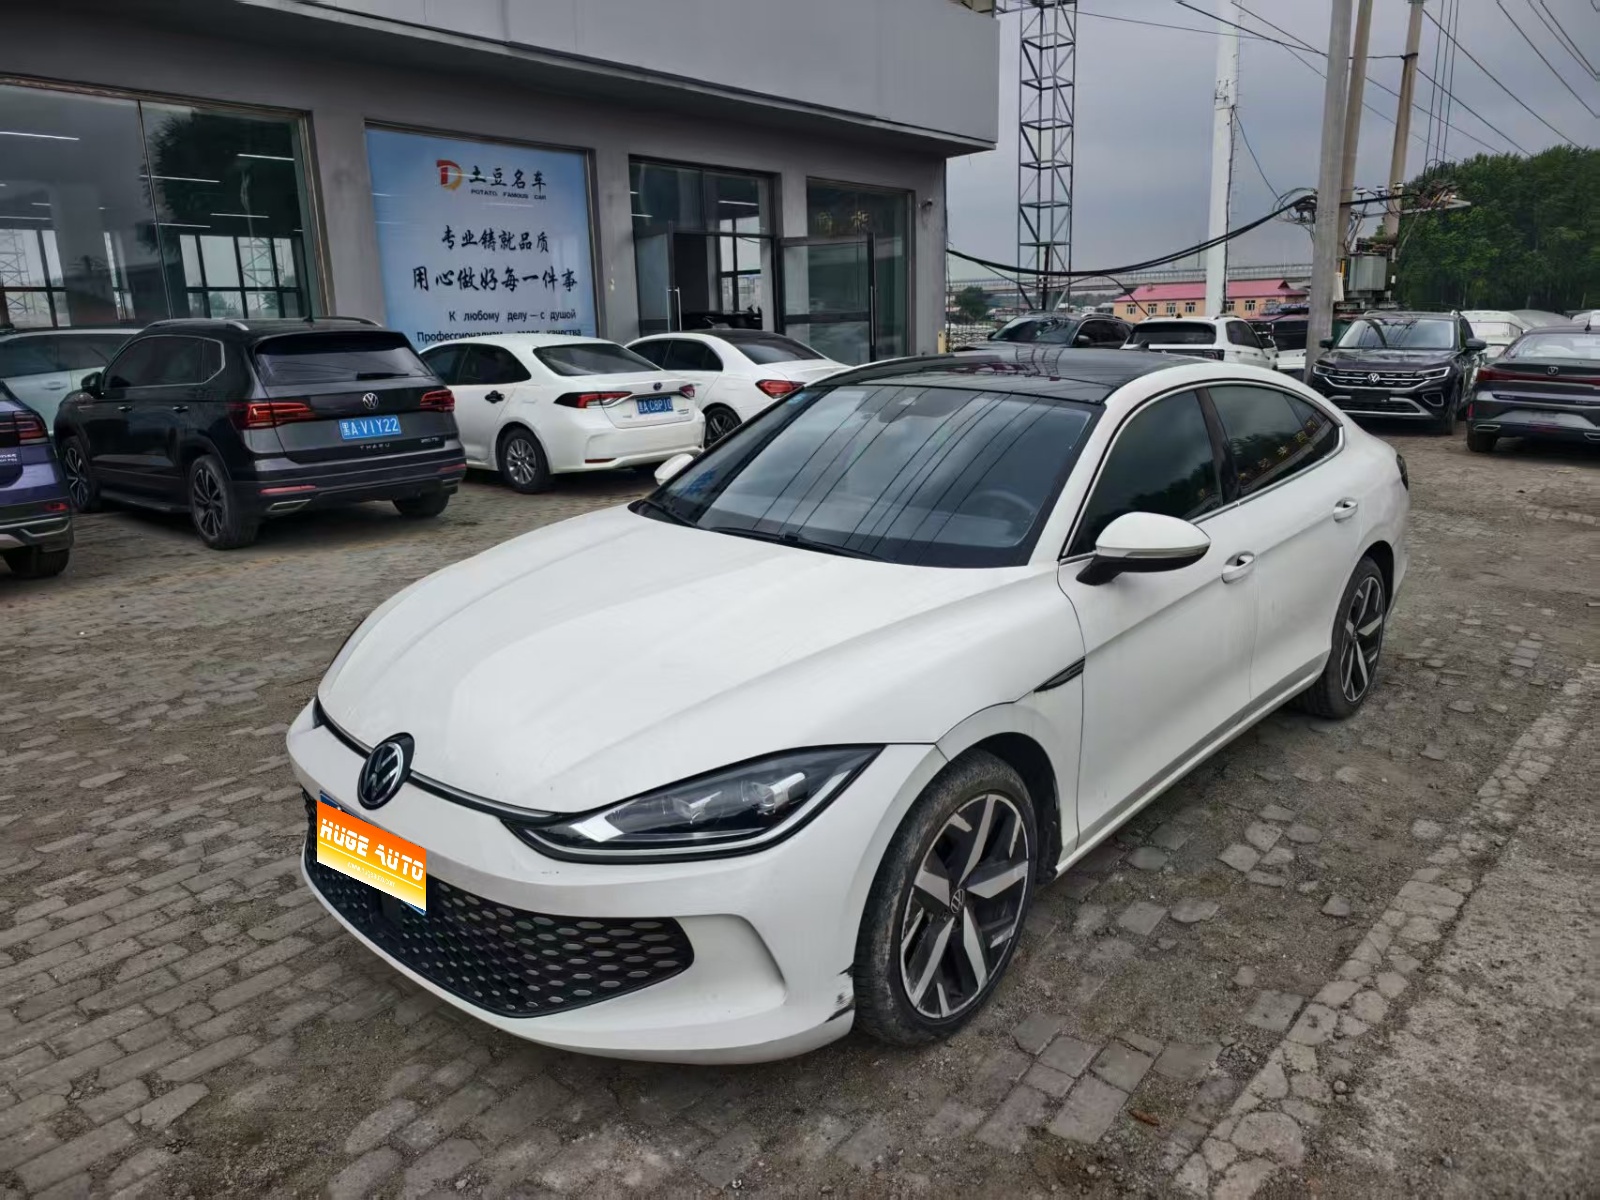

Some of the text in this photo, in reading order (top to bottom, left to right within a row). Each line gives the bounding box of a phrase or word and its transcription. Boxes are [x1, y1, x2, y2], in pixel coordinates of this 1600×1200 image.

[469, 165, 546, 193] 土豆名车
[471, 189, 498, 197] POTATO
[503, 191, 529, 199] FAMOUS
[442, 225, 549, 253] 专业铸就品质
[412, 265, 578, 292] 用心做好每一件事
[463, 309, 500, 323] любому
[507, 311, 528, 322] делу
[550, 309, 577, 322] душой
